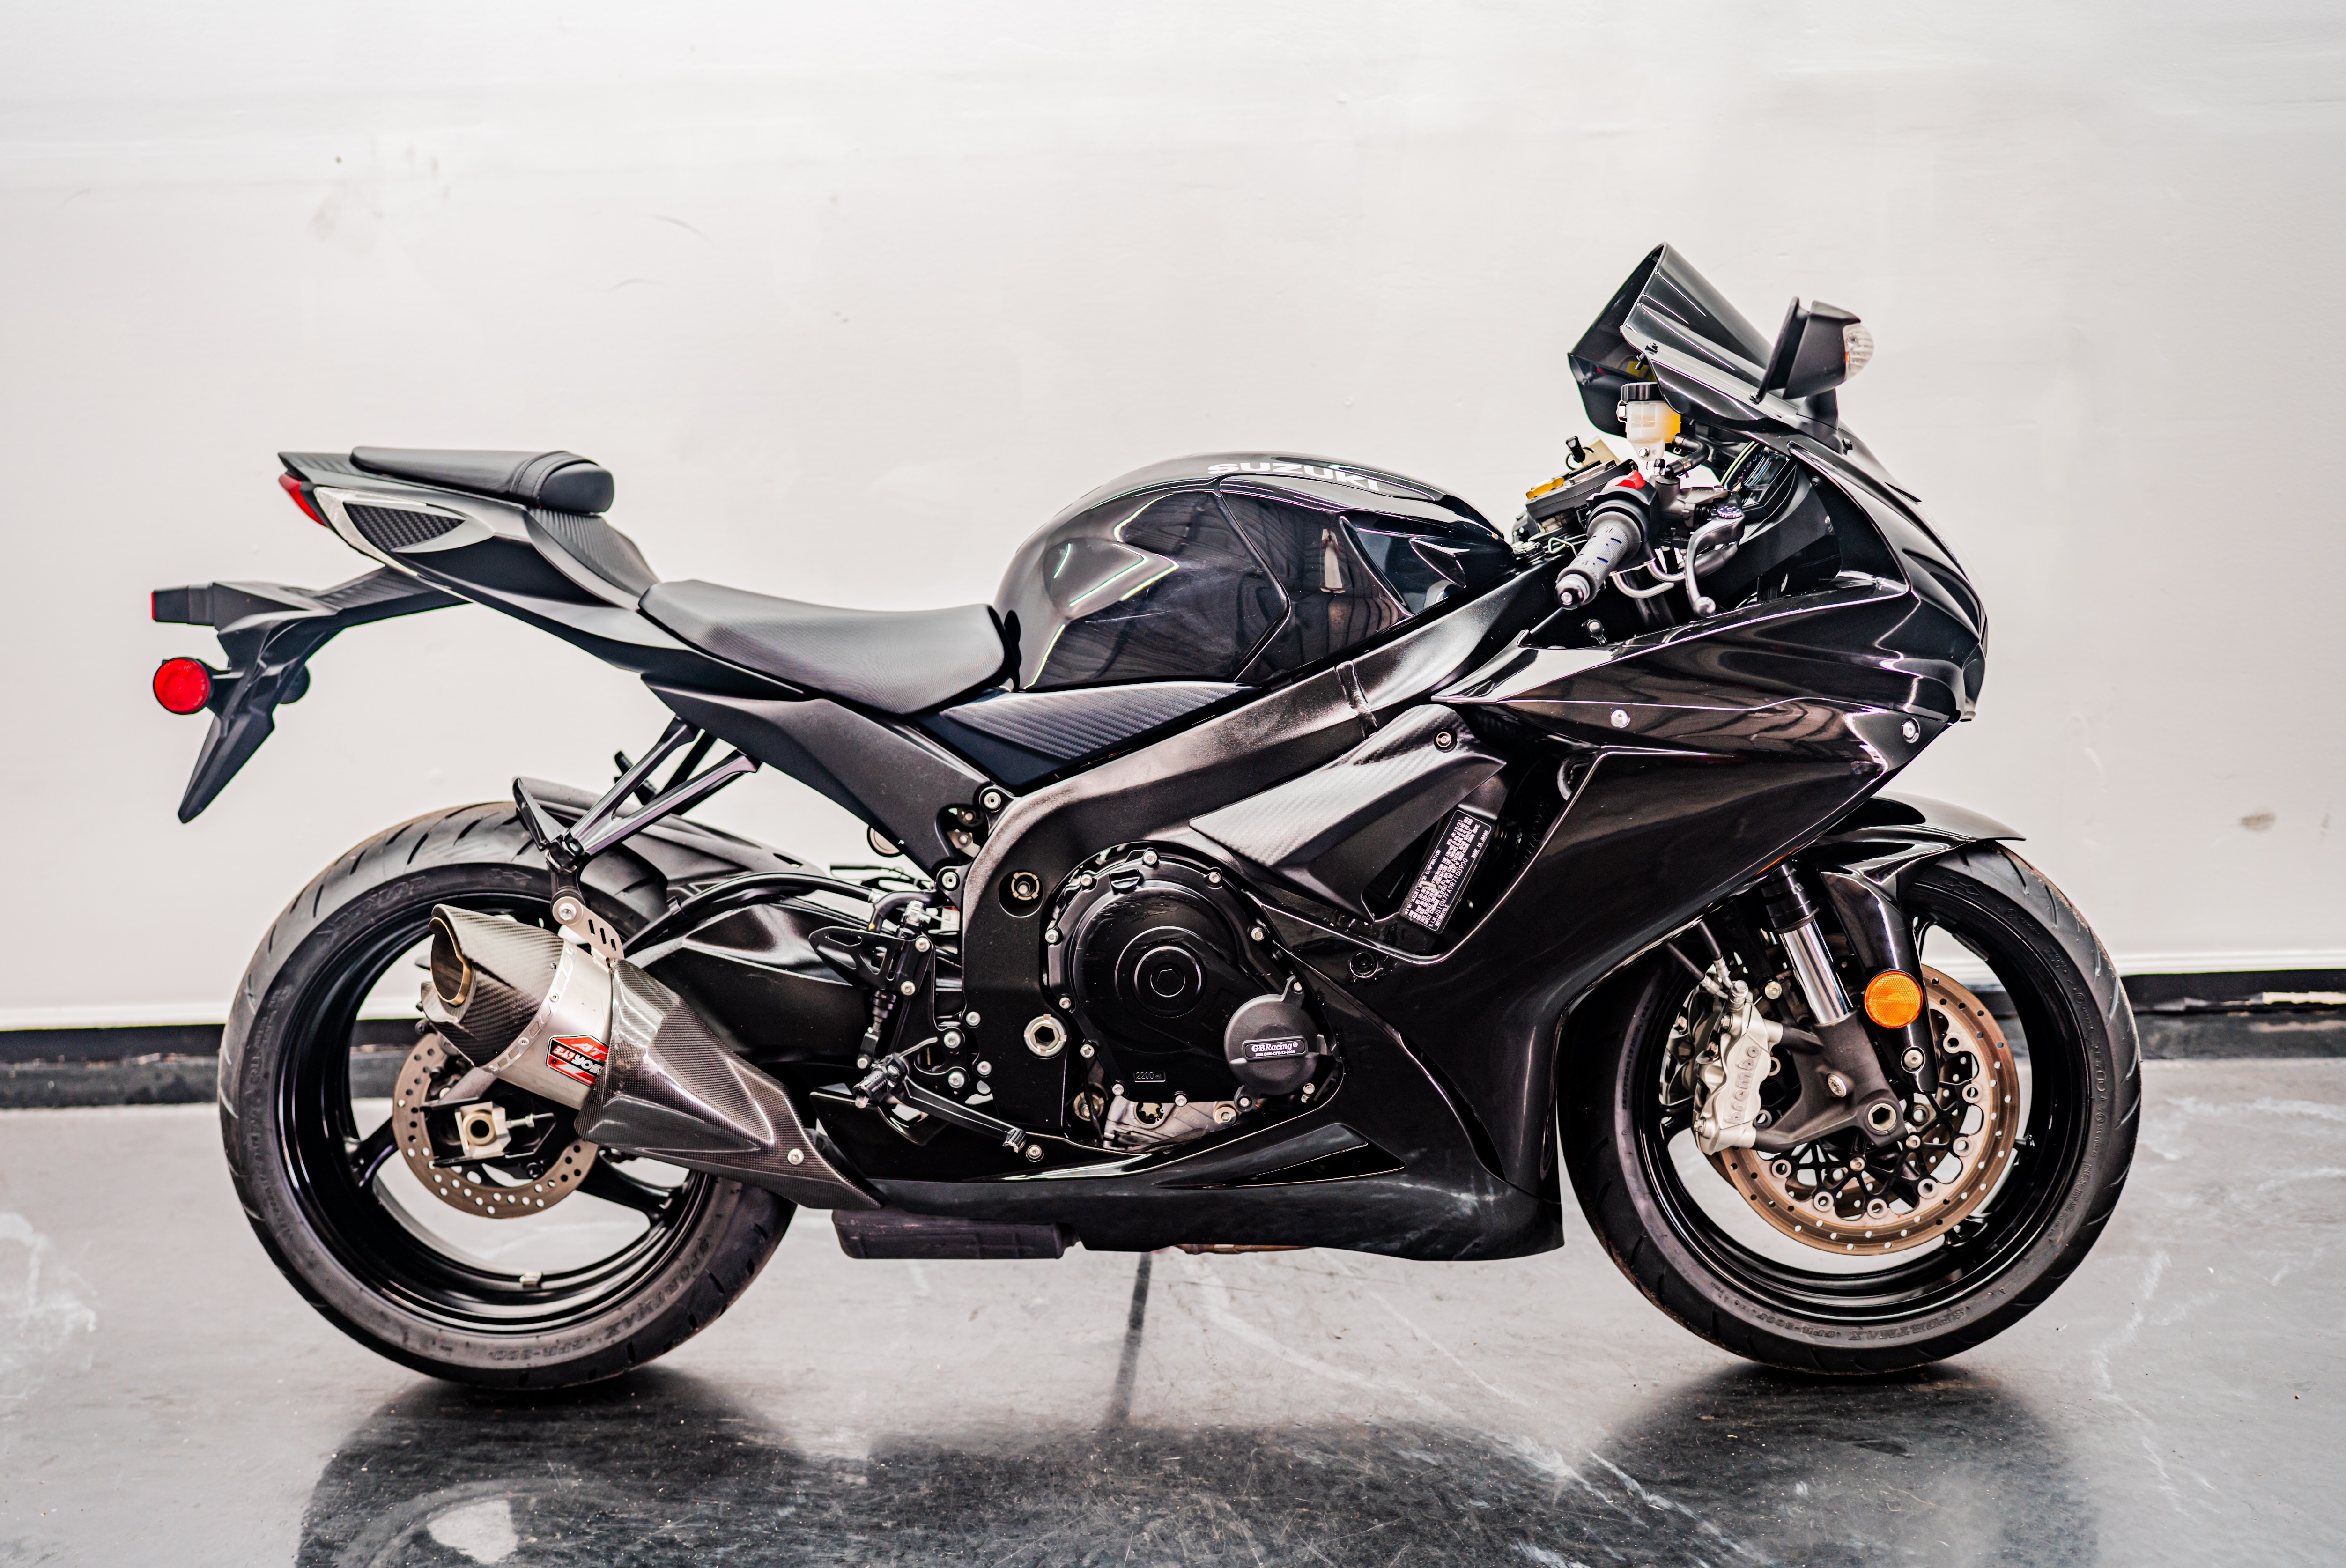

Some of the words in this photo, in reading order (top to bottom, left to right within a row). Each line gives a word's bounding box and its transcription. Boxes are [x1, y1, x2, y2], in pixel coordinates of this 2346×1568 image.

[1207, 462, 1380, 492] SUZUKI
[1480, 830, 1488, 842] JAPAN
[1410, 888, 1420, 902] SUZUKI
[1425, 849, 1441, 874] CORPORATION
[1423, 902, 1433, 915] VEHICLE
[1443, 862, 1454, 879] APPLICABLE
[1463, 828, 1473, 840] VEHICLE
[1435, 858, 1467, 916] JS1GN7FA9R7100900
[1435, 904, 1449, 926] MOTORCYCLE
[1725, 1045, 1759, 1124] brembo
